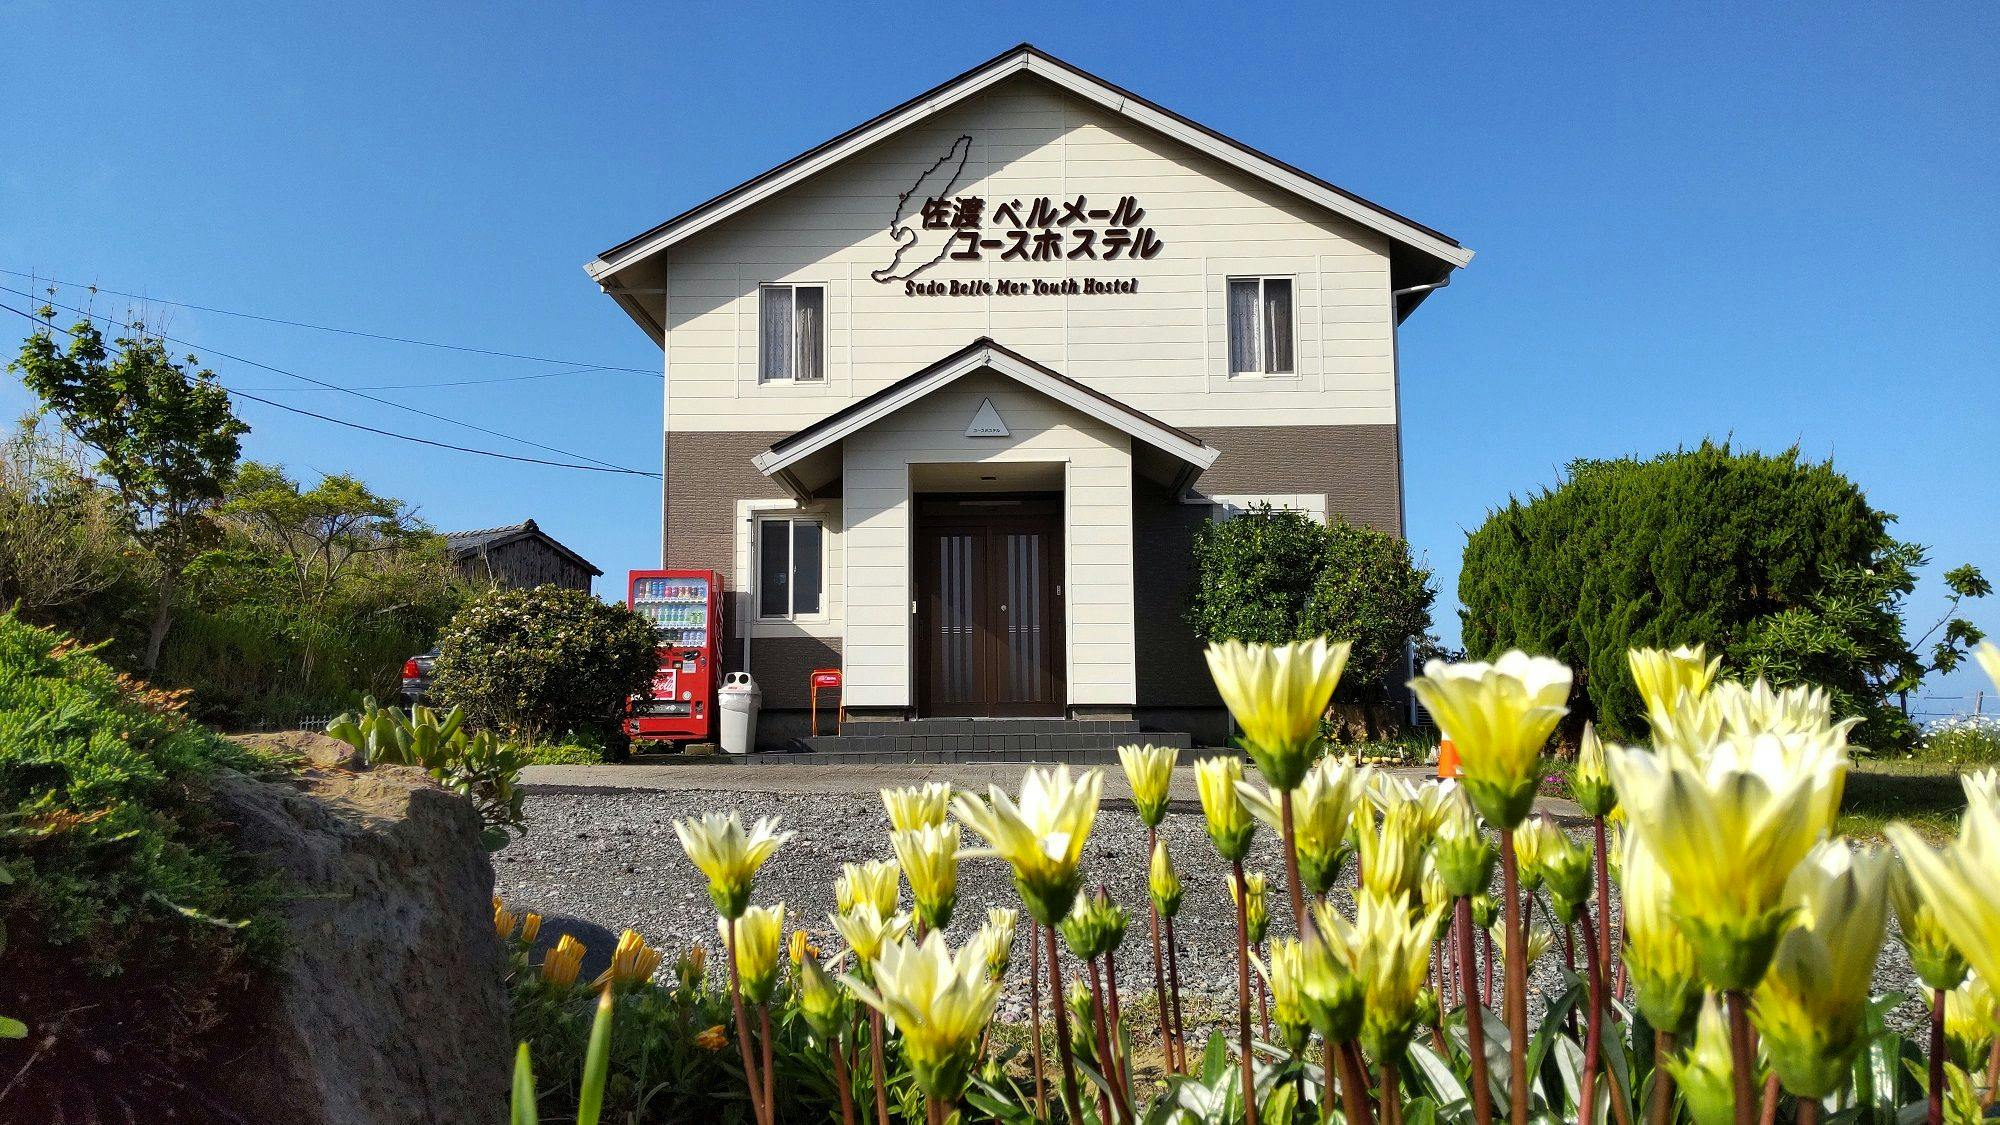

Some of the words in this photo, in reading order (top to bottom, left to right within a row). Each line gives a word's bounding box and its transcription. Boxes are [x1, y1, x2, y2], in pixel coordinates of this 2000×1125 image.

[921, 196, 984, 228] 佐渡
[993, 195, 1144, 228] ベルメール
[951, 228, 1162, 261] ユースホステル
[905, 279, 946, 296] Sado
[949, 279, 991, 296] Belle
[996, 279, 1028, 296] Mer
[1032, 278, 1078, 296] Youth
[1083, 277, 1137, 295] Hostel
